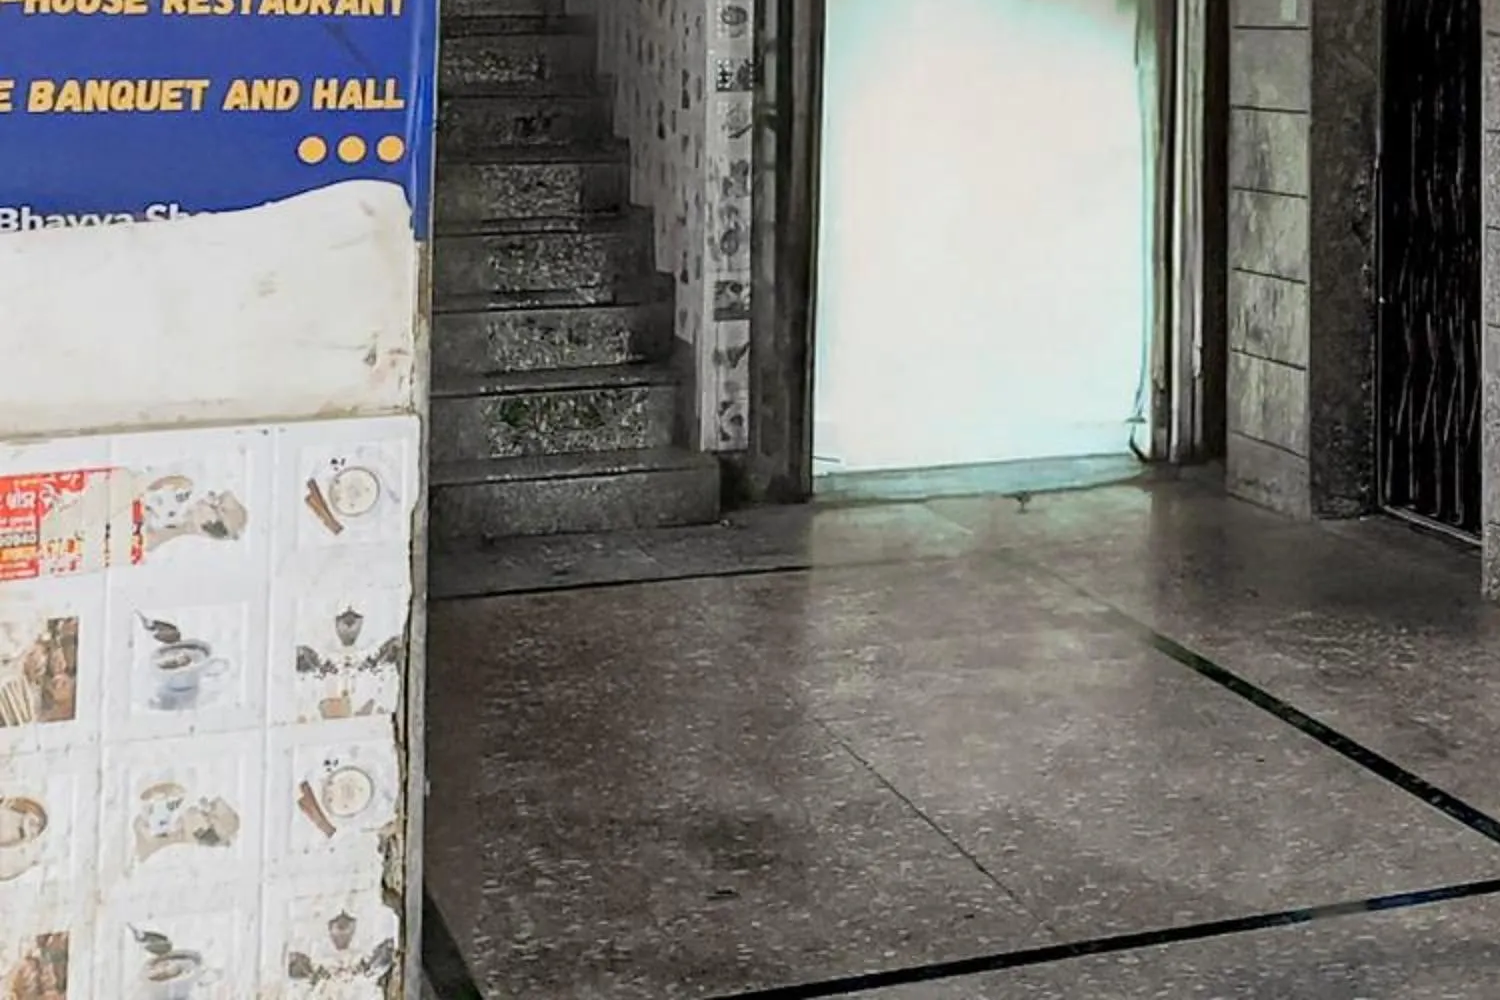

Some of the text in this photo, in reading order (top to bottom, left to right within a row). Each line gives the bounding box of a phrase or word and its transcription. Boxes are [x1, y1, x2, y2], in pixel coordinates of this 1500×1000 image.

[27, 79, 211, 114] BANQUET
[222, 79, 300, 112] AND
[312, 78, 405, 111] HALL
